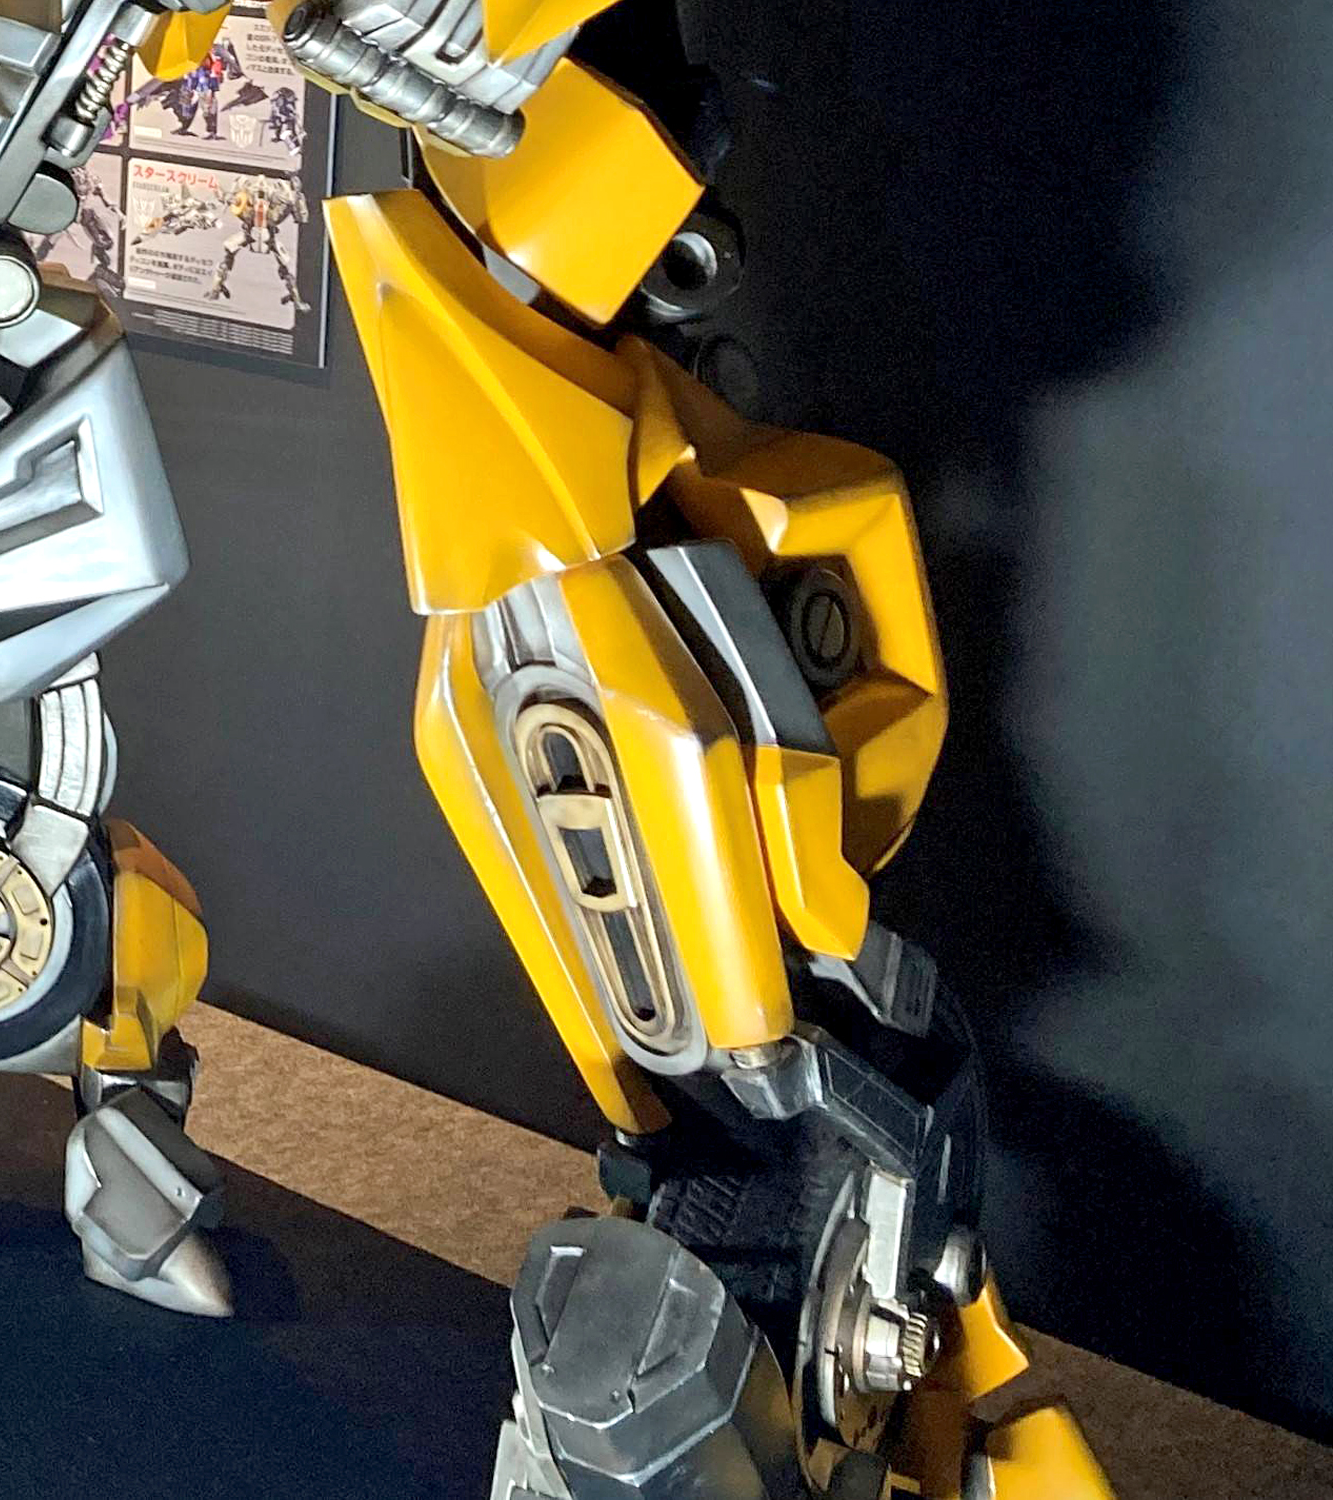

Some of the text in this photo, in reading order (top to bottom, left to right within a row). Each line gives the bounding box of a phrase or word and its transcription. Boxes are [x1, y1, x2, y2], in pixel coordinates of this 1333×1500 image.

[134, 165, 218, 189] スタースクリーム
